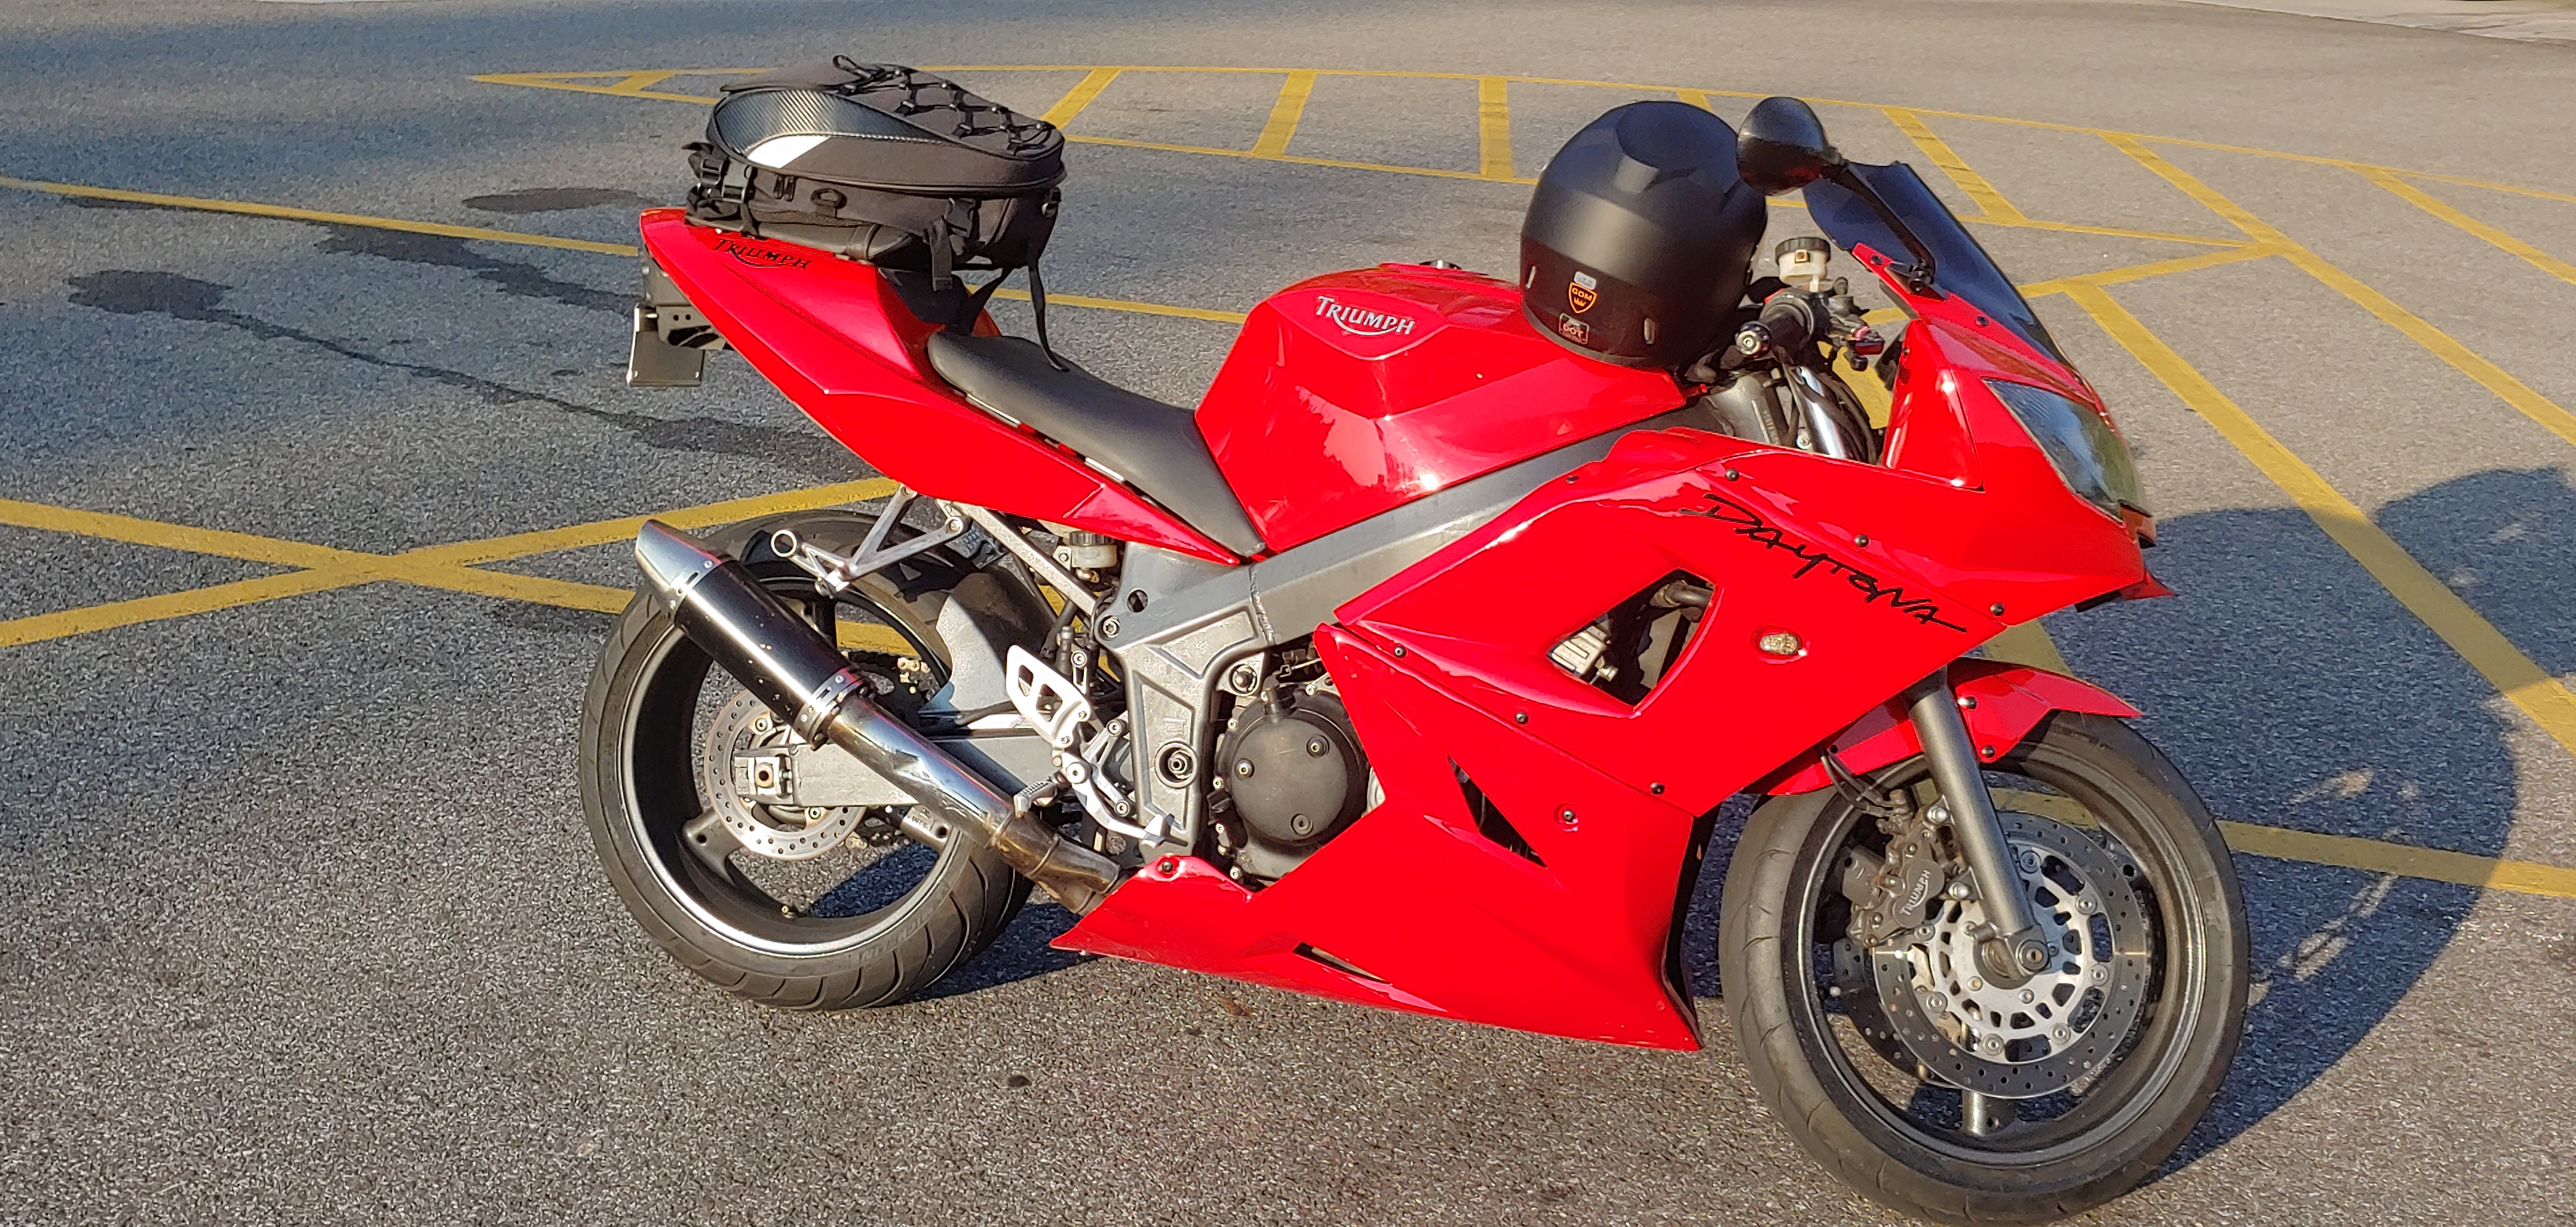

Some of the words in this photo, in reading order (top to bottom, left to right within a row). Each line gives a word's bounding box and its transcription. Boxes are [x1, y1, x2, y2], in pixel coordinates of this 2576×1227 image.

[714, 238, 812, 269] TRIUMPH
[1572, 287, 1593, 301] GDM
[1315, 295, 1415, 335] TRIUMPH
[1563, 323, 1584, 338] DOT
[1679, 493, 1967, 633] DAYTONA
[1899, 870, 1931, 916] TRIUMPH
